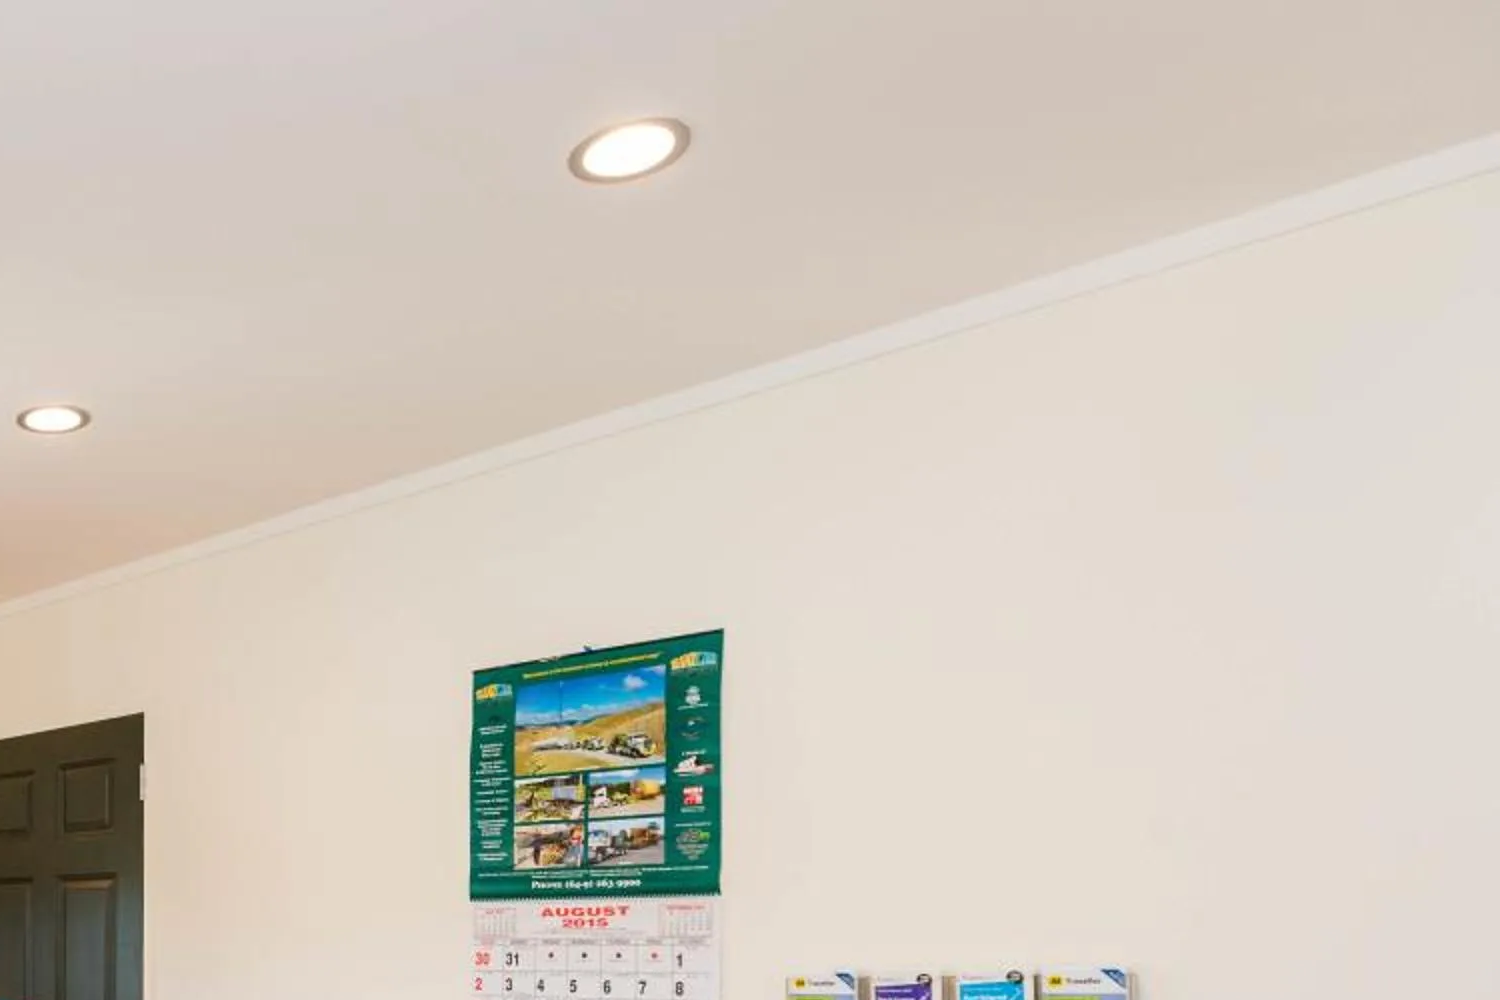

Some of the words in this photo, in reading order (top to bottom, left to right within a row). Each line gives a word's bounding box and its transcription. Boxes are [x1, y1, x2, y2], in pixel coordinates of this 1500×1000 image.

[541, 904, 631, 917] AUGUST
[562, 918, 609, 929] 2015
[475, 952, 490, 966] 30
[505, 952, 520, 966] 31
[676, 954, 684, 967] 1
[475, 978, 483, 991] 2
[505, 978, 513, 991] 3
[537, 979, 545, 992] 4
[569, 980, 577, 993] 5
[603, 980, 611, 994] 6
[638, 981, 647, 995] 7
[675, 982, 684, 996] 8
